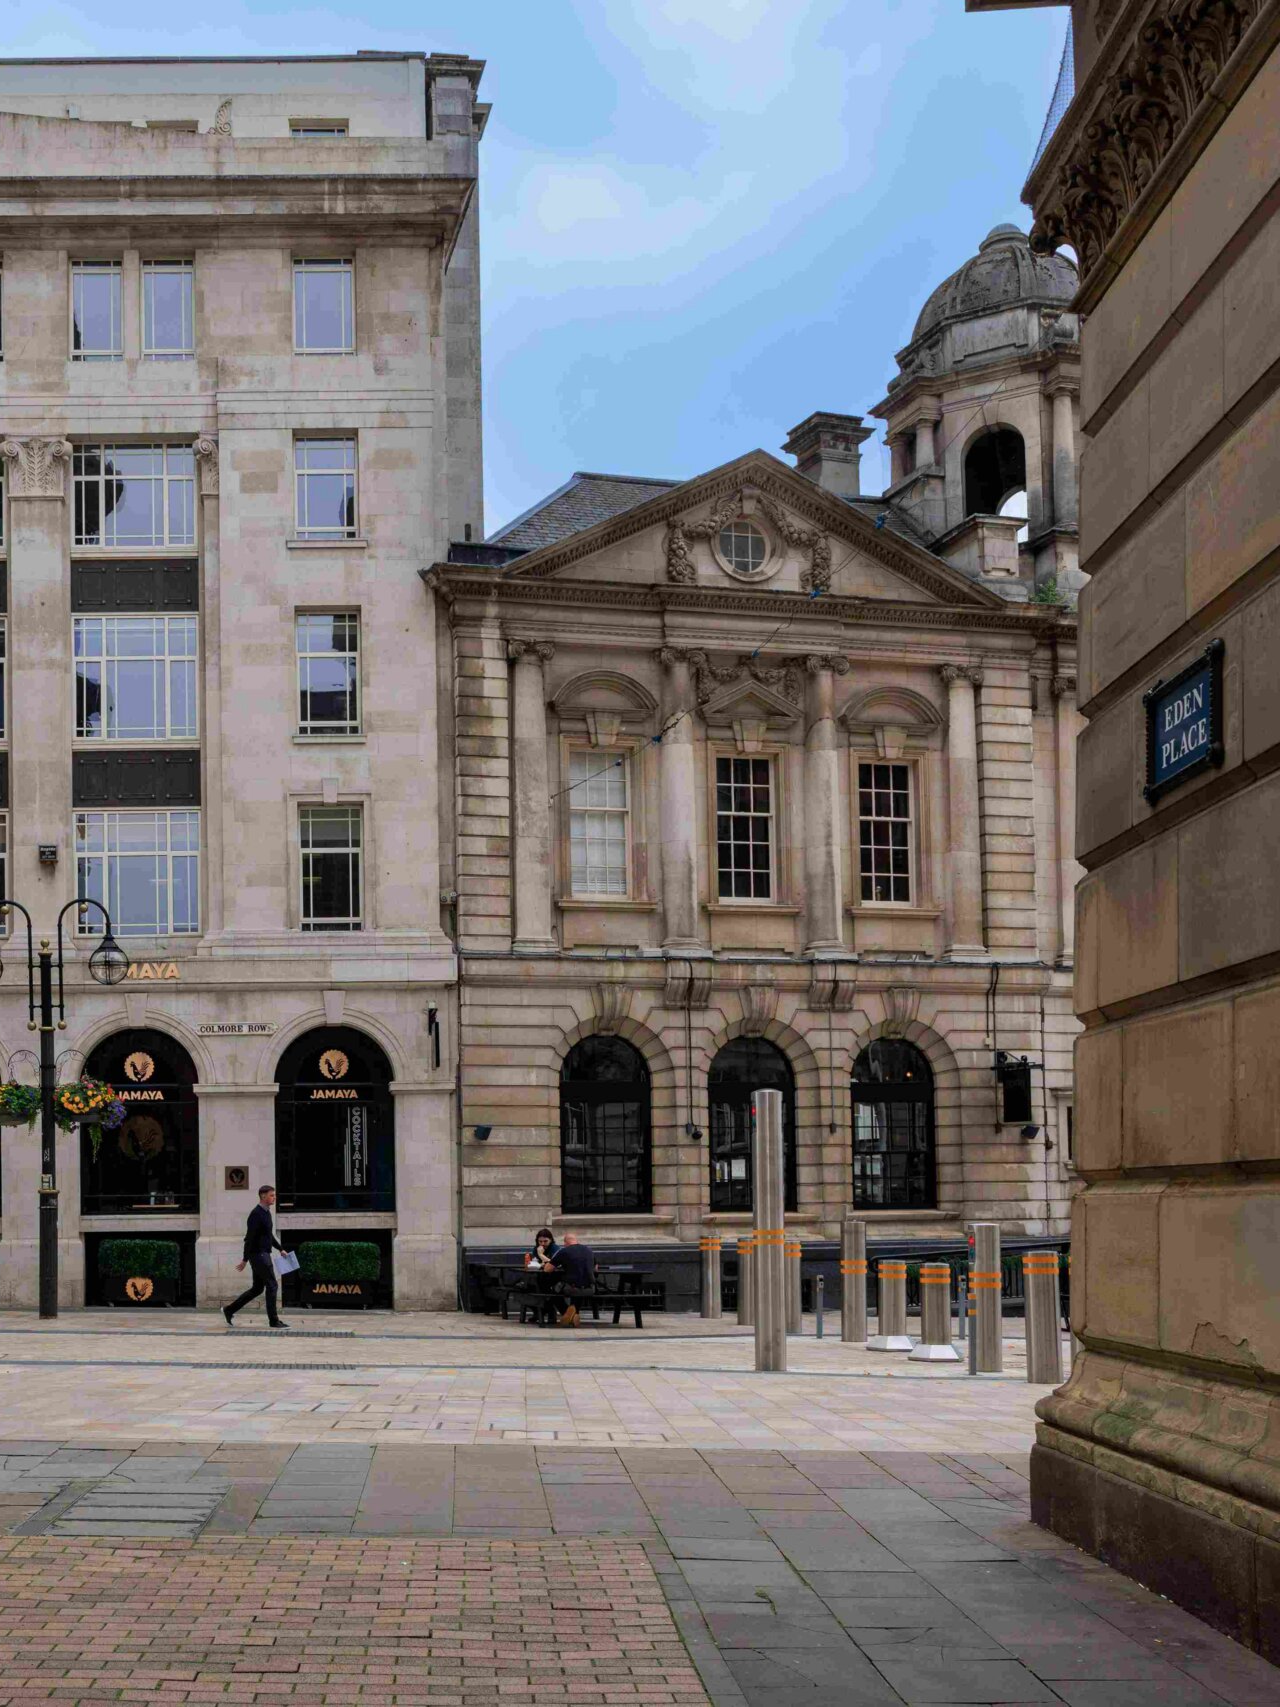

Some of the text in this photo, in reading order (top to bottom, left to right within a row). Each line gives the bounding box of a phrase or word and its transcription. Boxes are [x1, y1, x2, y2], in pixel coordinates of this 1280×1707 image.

[1164, 682, 1204, 733] EDEN
[1161, 718, 1207, 769] PLACE
[126, 962, 181, 979] MAYA
[200, 1024, 244, 1033] COLMORE
[248, 1024, 267, 1033] ROW
[118, 1090, 165, 1100] JAMAYA
[310, 1089, 358, 1099] JAMAYA
[312, 1283, 362, 1295] JAMAYA
